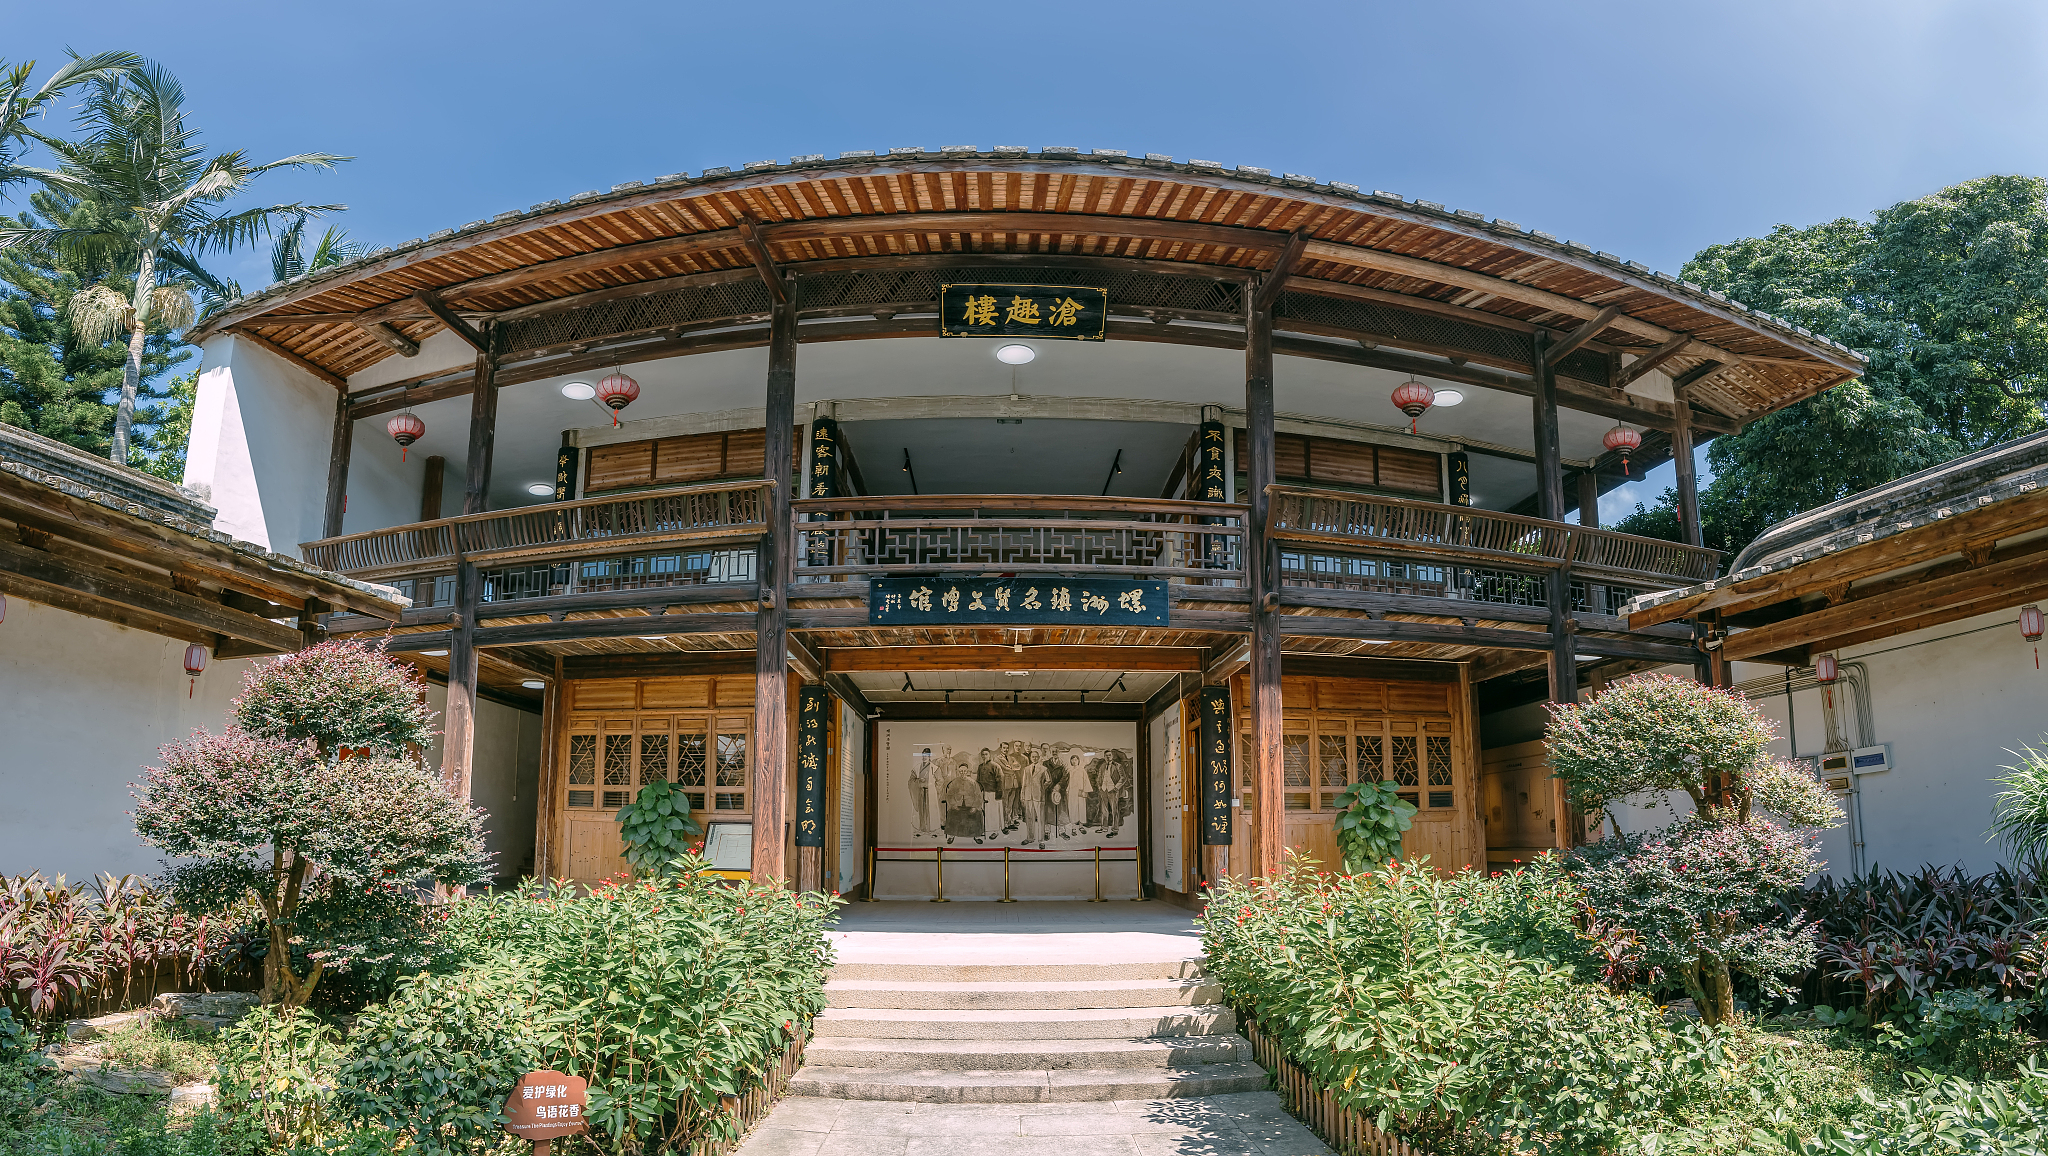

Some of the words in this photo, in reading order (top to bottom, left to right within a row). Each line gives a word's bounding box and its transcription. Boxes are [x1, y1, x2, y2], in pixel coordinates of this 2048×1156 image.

[963, 295, 1085, 327] 滄趣樓
[522, 1085, 567, 1100] 爱护绿化
[535, 1103, 580, 1119] 鸟语花香
